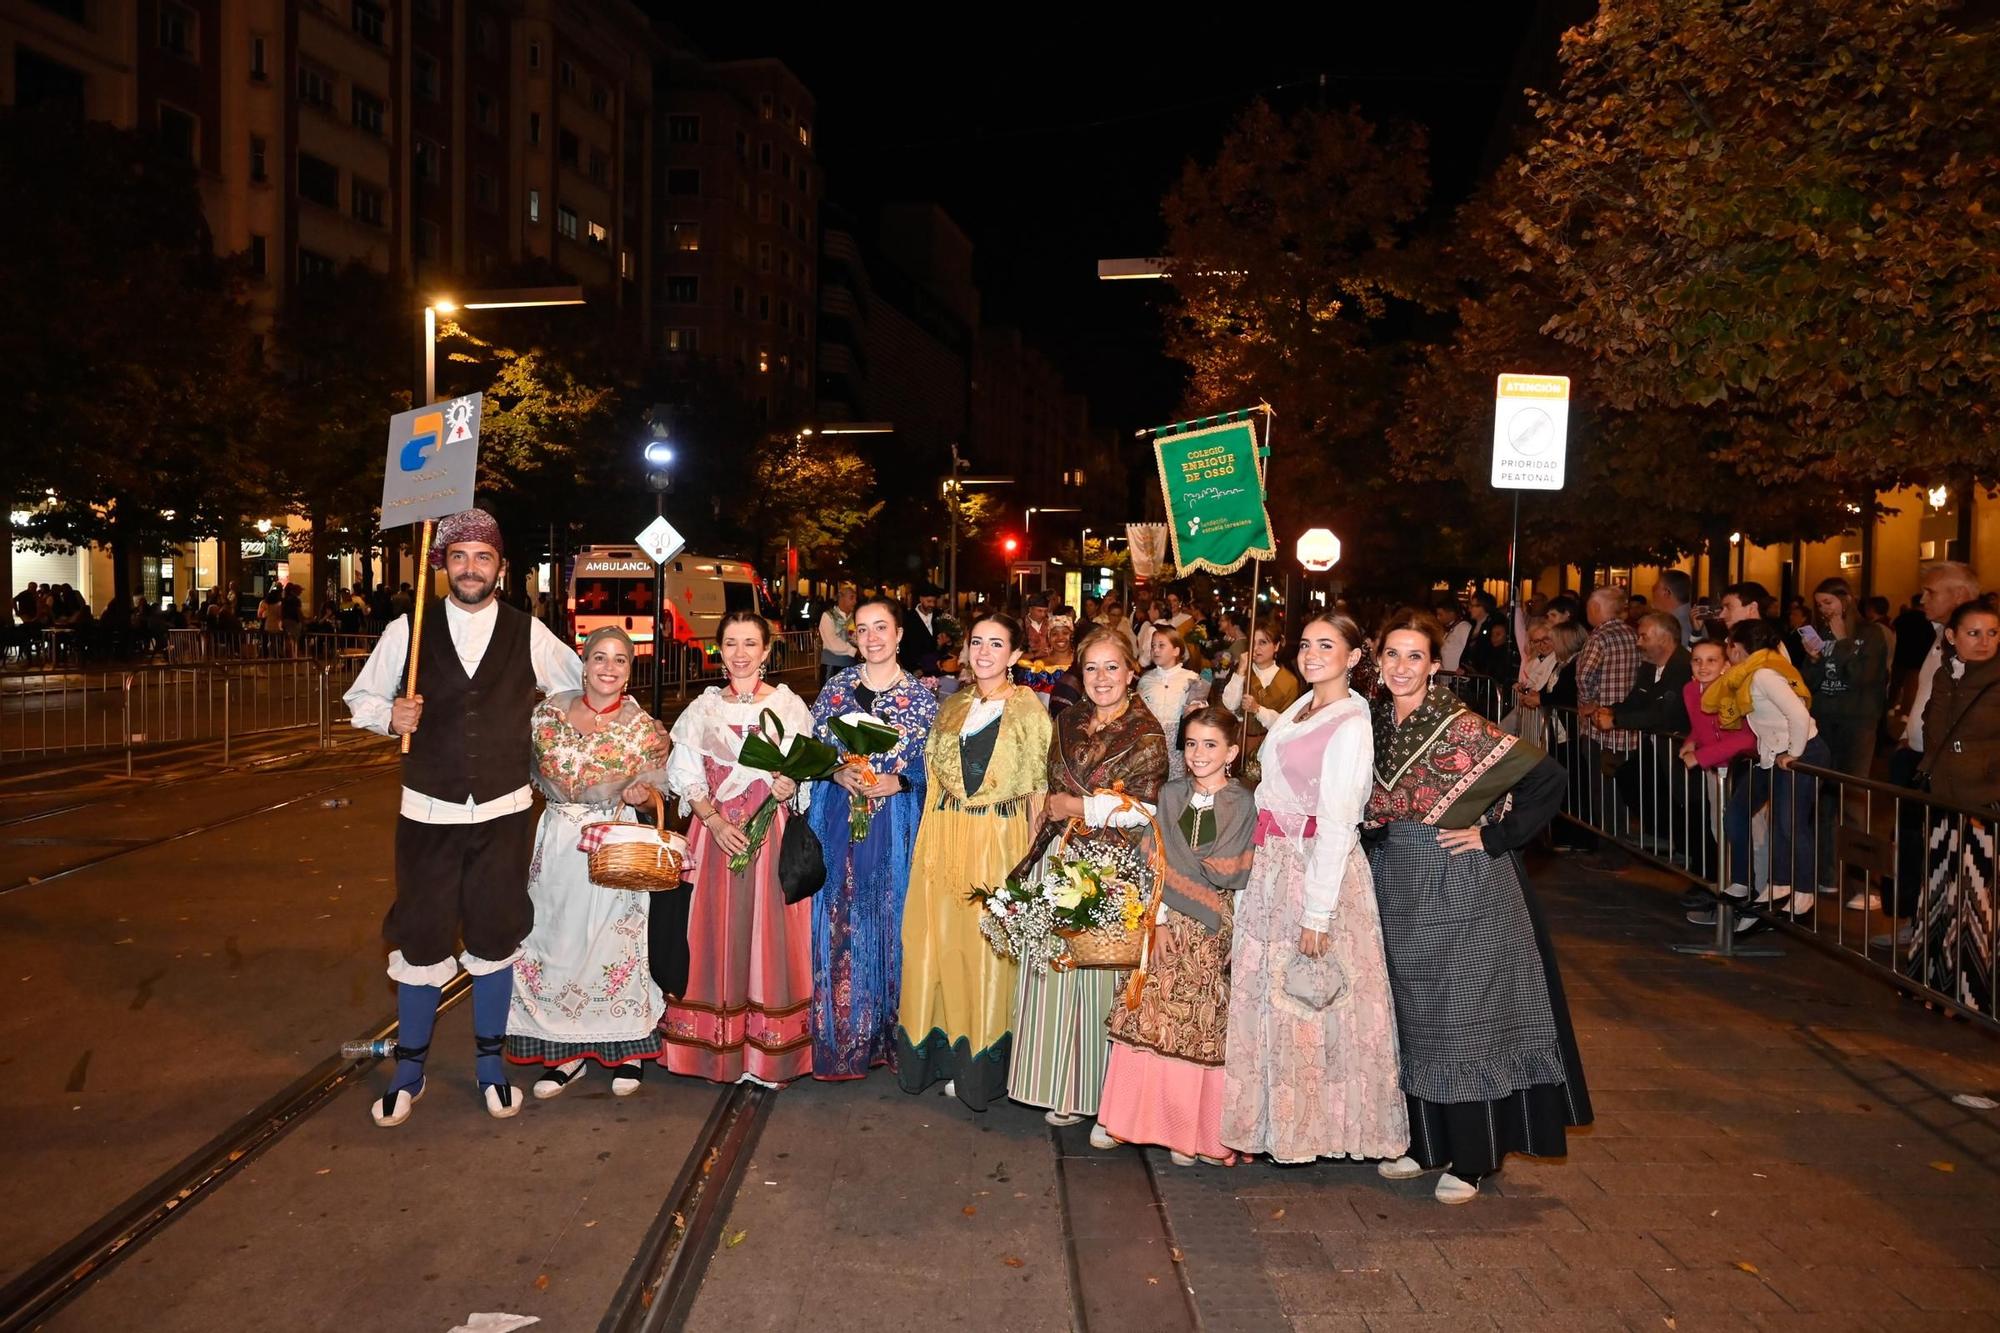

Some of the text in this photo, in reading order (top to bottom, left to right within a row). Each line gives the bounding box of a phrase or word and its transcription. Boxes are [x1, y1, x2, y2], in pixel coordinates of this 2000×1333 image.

[1187, 446, 1225, 459] COLEGIO
[1181, 454, 1235, 472] ENRIQUE
[1501, 459, 1558, 469] PRIORIDAD
[1185, 472, 1201, 483] DE
[1501, 473, 1555, 482] PEATONAL
[650, 532, 671, 548] 30
